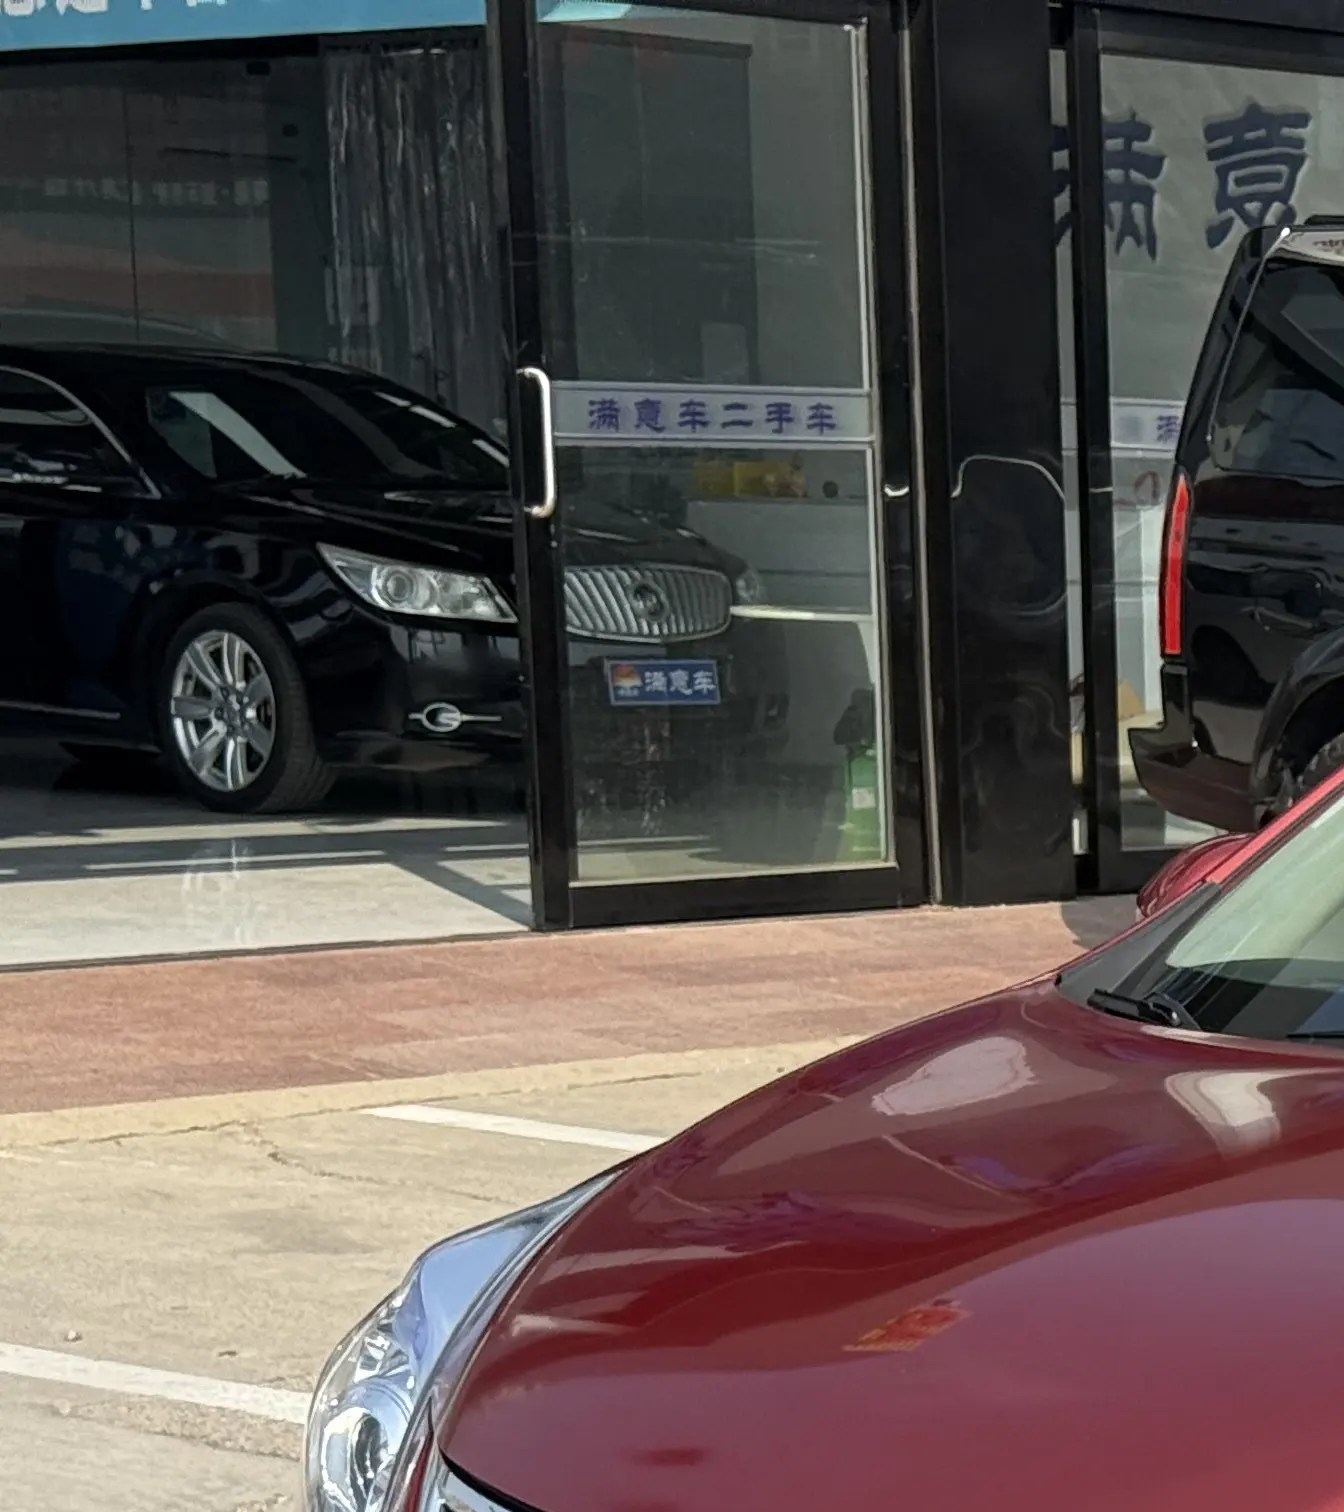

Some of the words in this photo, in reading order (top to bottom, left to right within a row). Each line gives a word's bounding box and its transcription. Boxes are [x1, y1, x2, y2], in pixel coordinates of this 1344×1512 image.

[588, 398, 837, 435] 满意车二手车
[643, 669, 716, 696] 满意车
